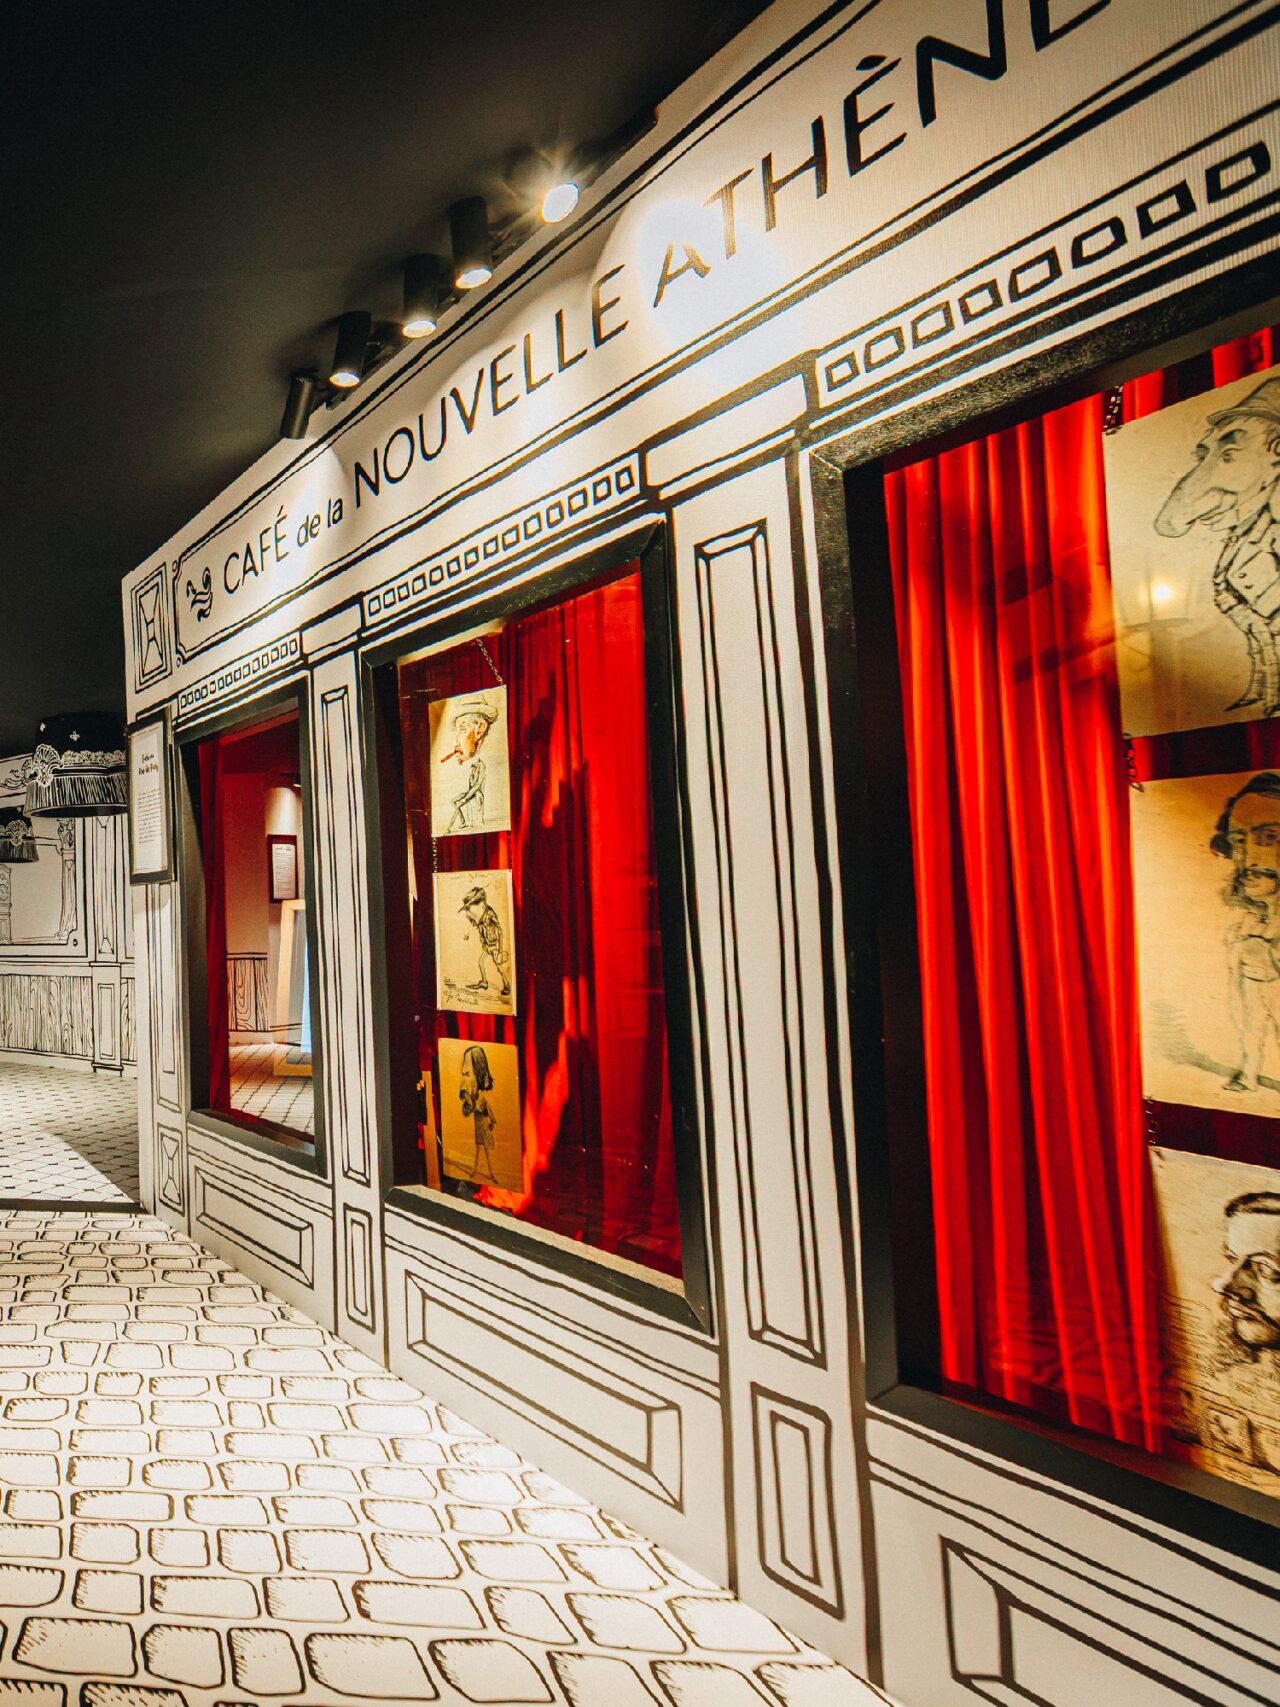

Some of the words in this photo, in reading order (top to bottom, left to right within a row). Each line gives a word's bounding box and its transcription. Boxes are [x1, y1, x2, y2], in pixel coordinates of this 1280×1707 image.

[224, 505, 290, 594] CAFÉ
[297, 514, 321, 547] de
[327, 498, 343, 528] la
[354, 265, 630, 508] NOUVELLE
